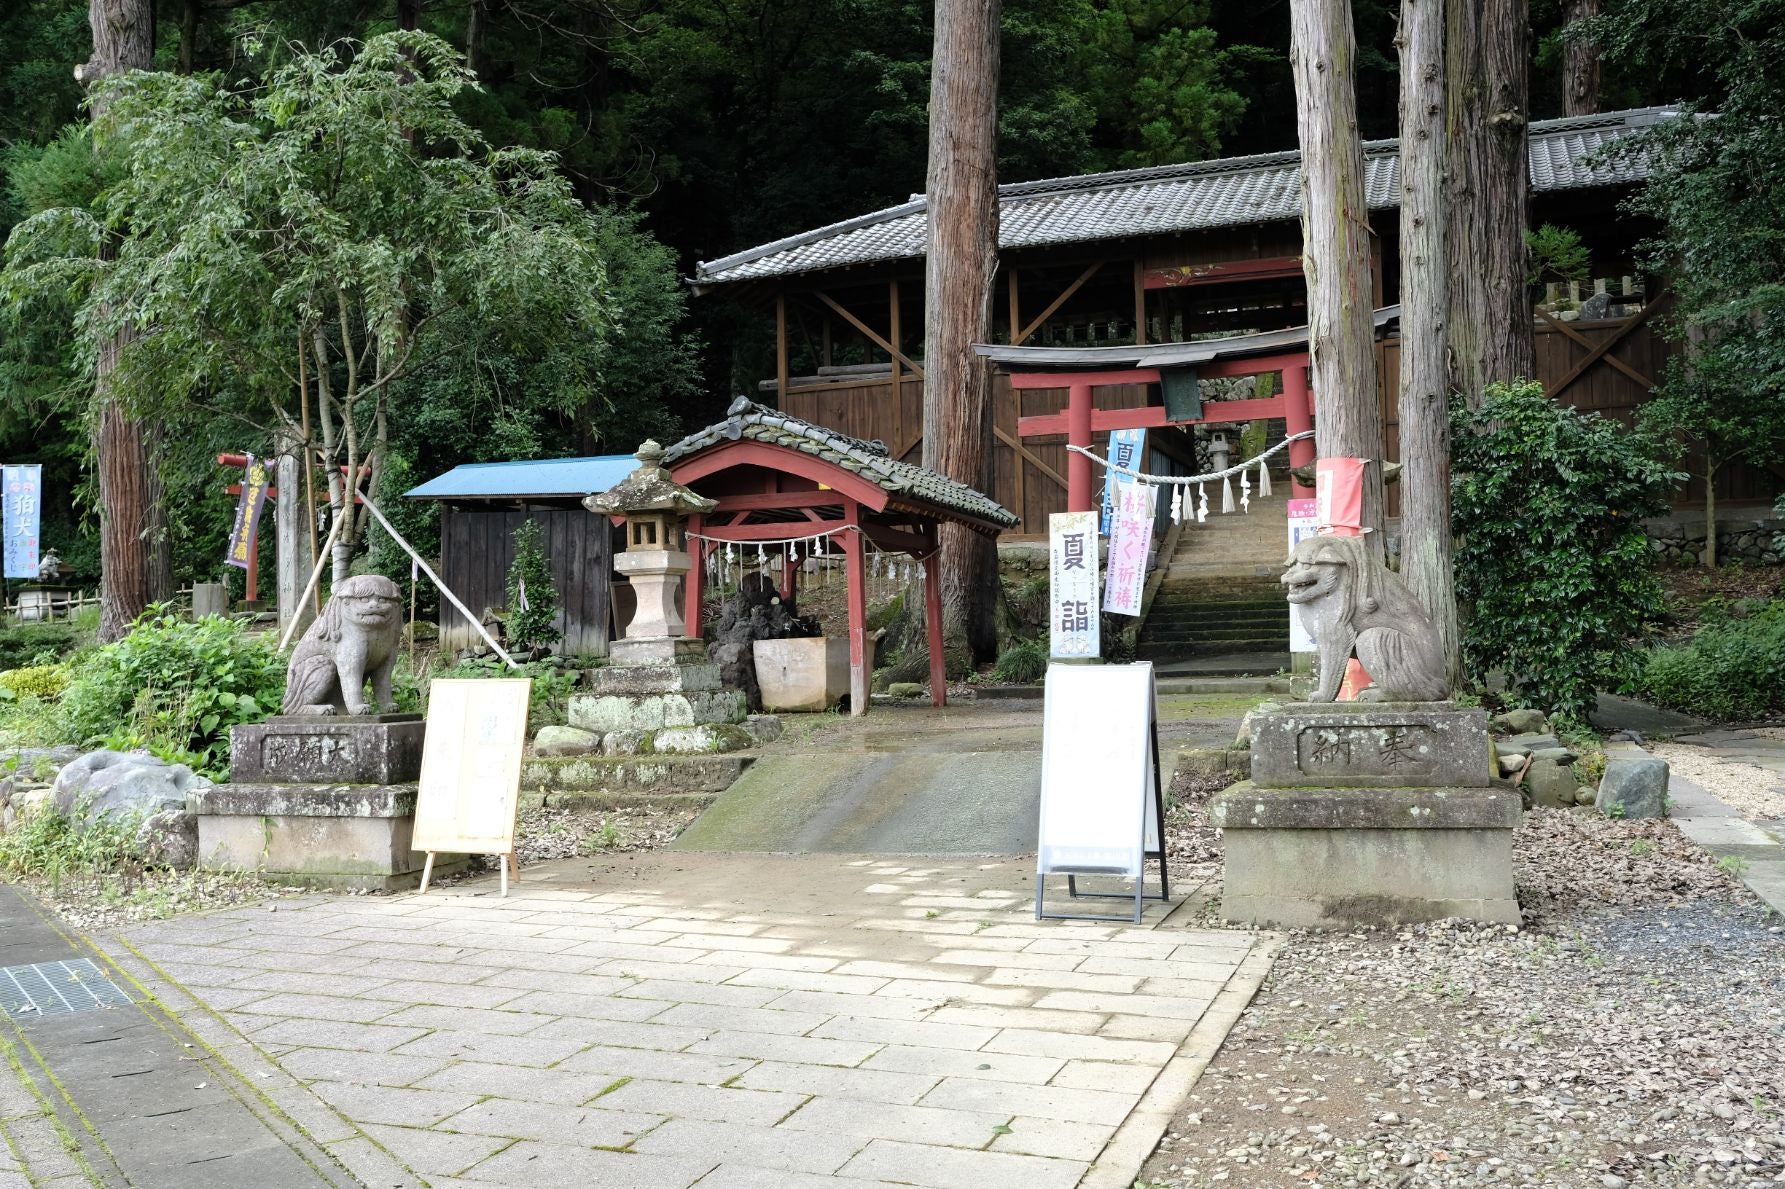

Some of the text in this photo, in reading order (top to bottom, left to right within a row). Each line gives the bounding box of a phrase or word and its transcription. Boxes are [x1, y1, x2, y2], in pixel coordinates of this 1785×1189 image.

[11, 494, 36, 537] 狛犬
[9, 539, 18, 573] おみくじ
[1061, 532, 1089, 633] 夏詣
